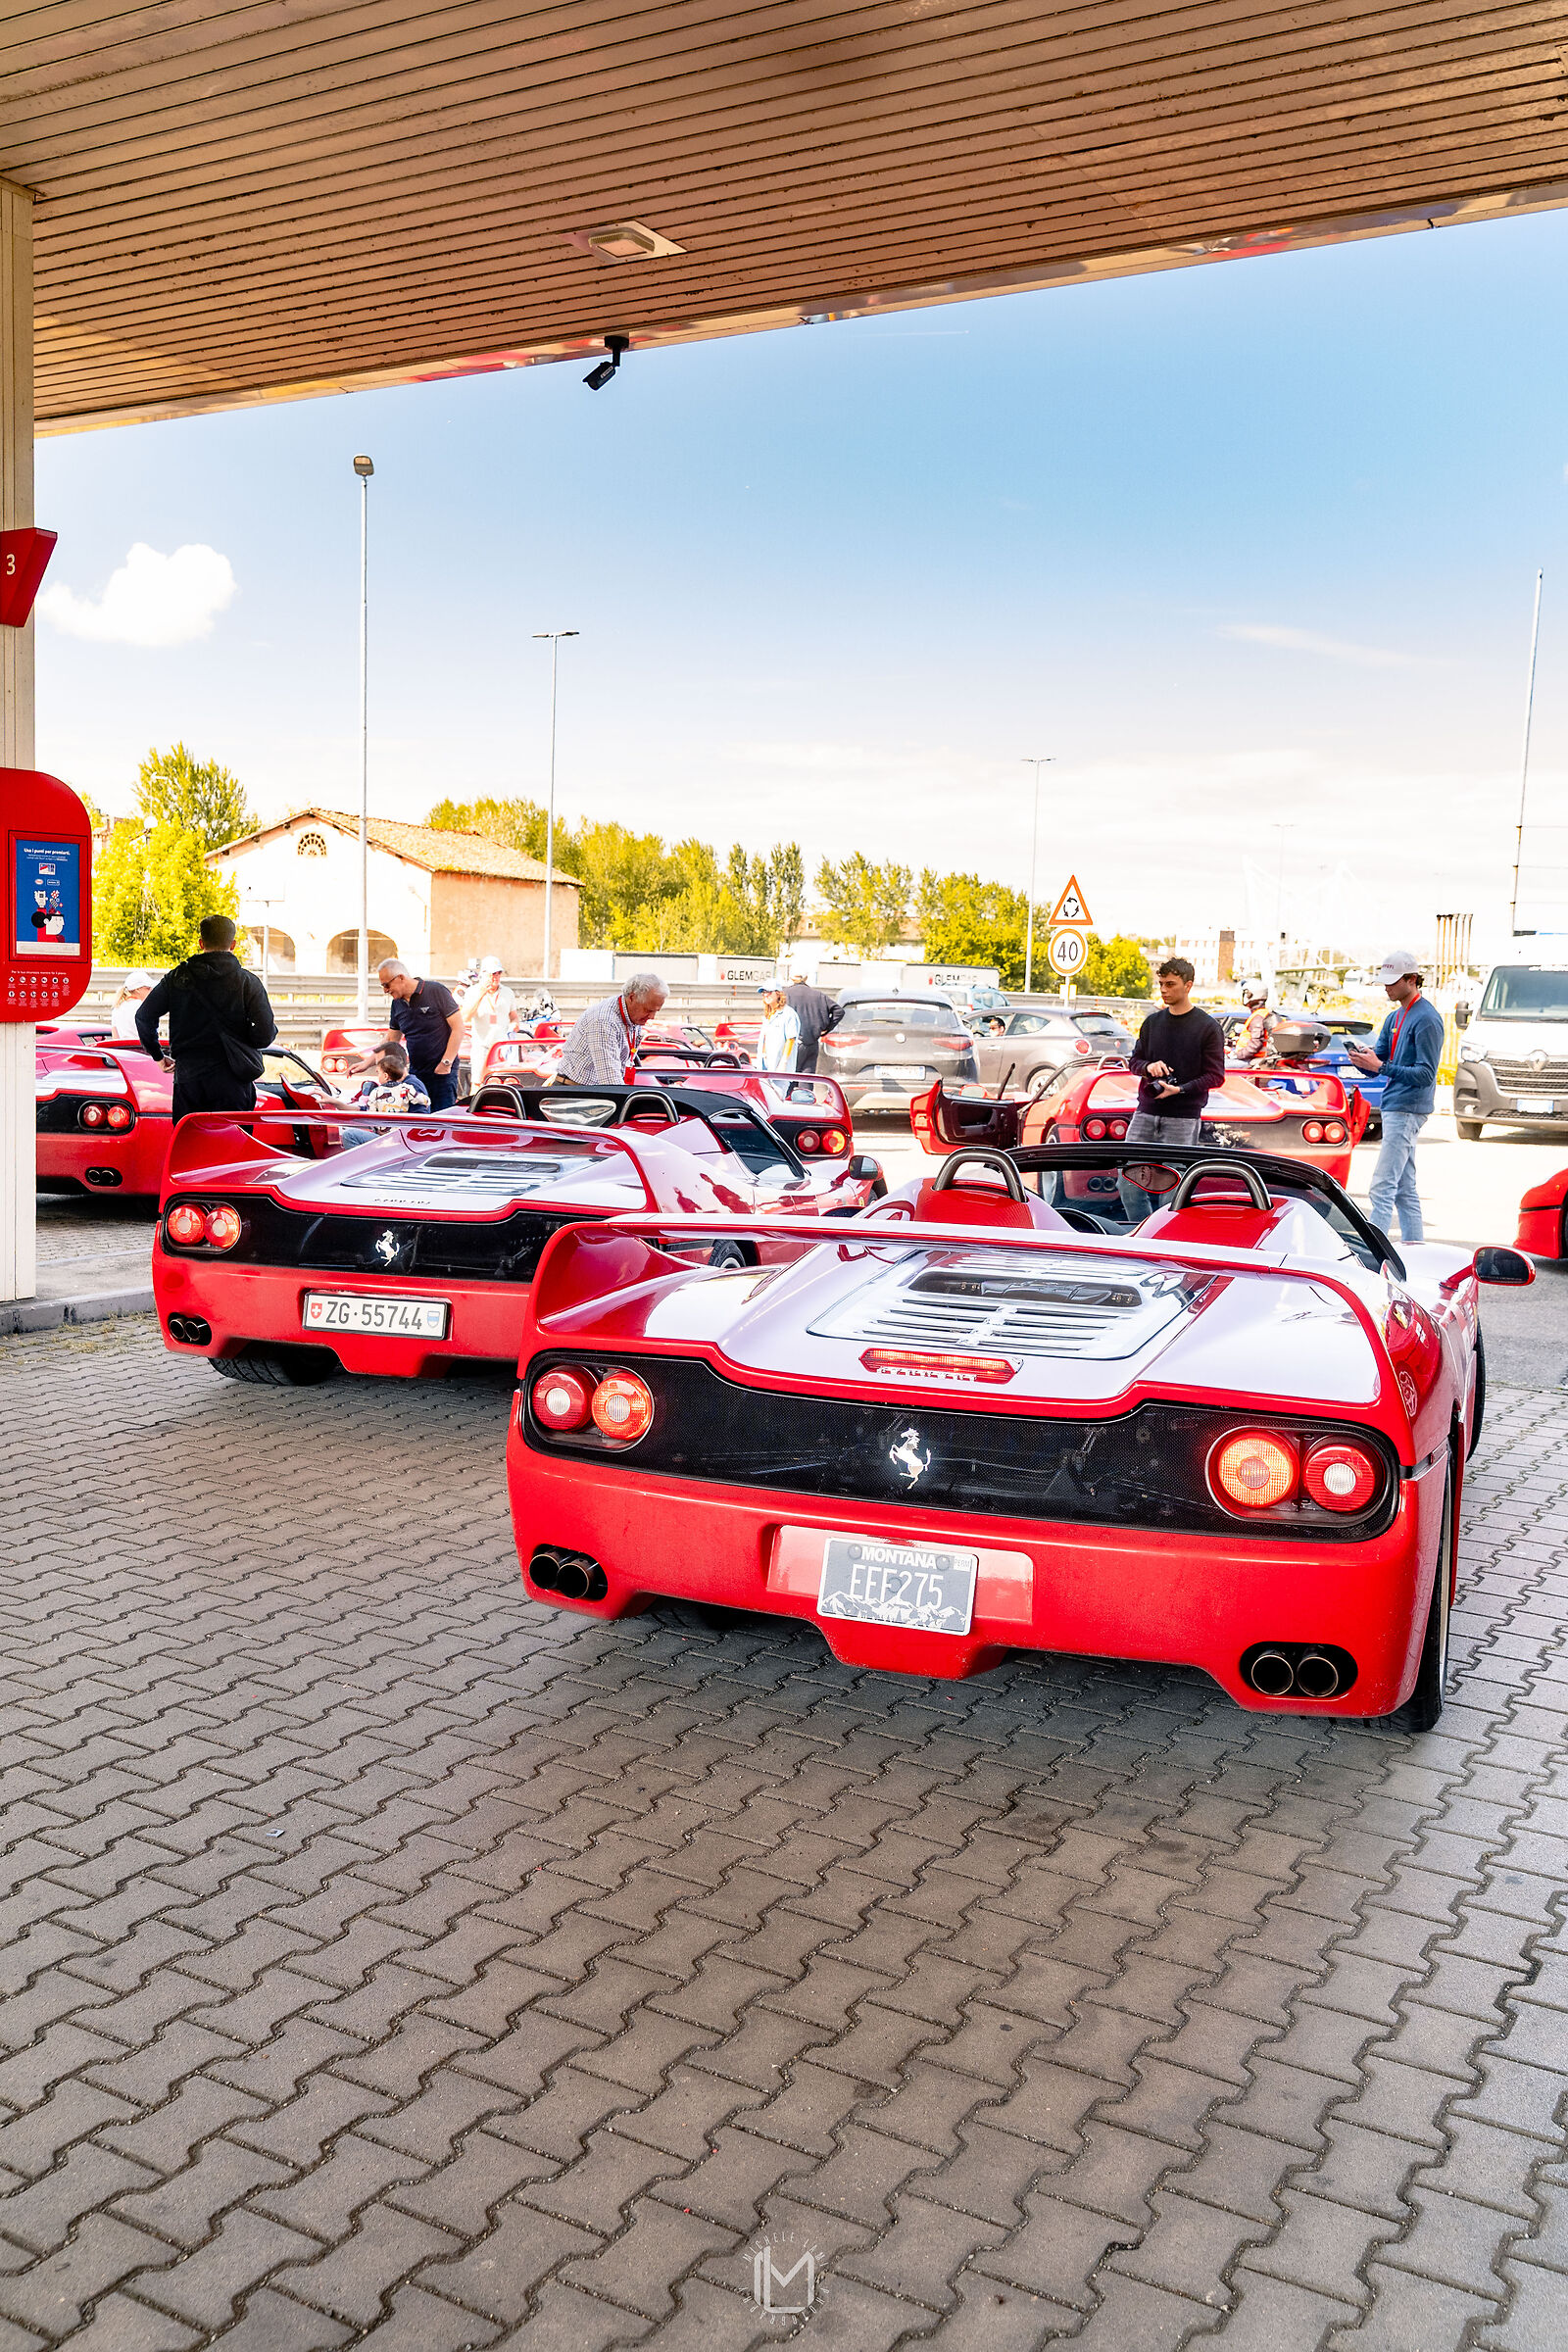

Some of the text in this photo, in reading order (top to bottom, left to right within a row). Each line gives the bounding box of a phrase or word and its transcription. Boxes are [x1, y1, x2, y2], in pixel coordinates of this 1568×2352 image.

[6, 554, 16, 575] 3
[1057, 941, 1079, 961] 40
[861, 1545, 938, 1570] MONTANA
